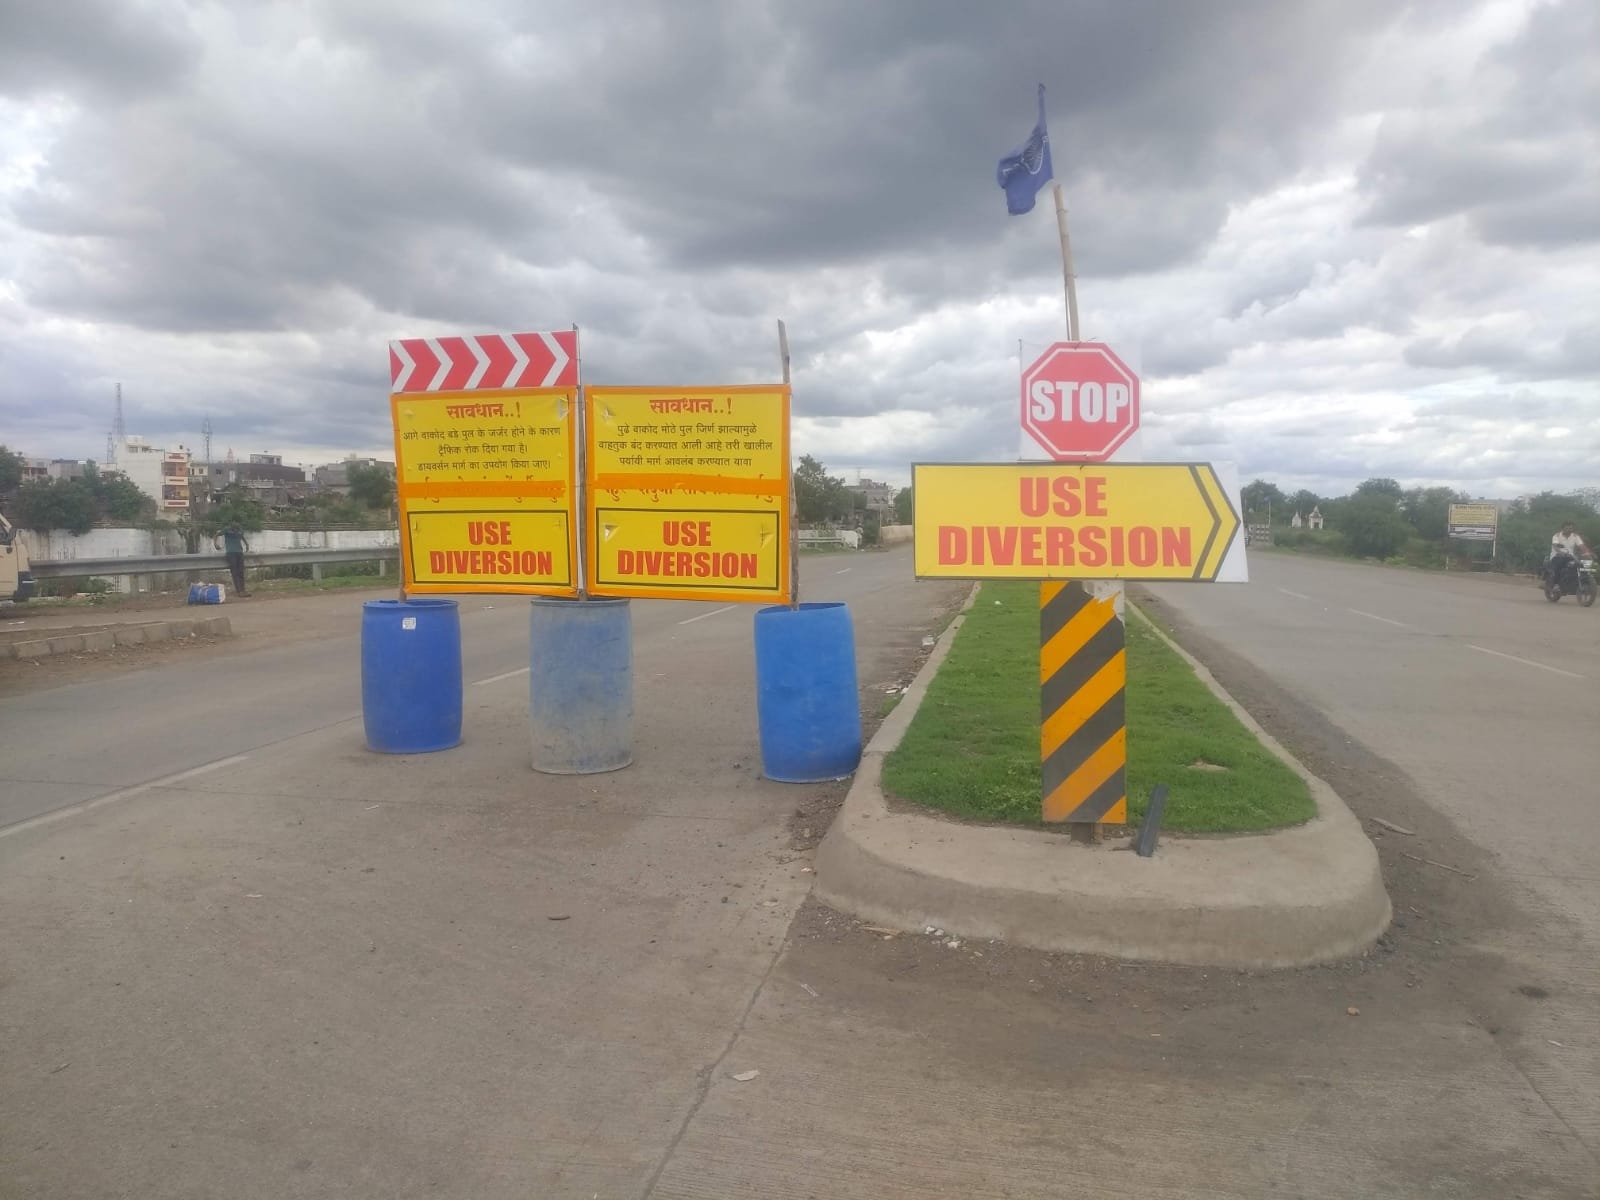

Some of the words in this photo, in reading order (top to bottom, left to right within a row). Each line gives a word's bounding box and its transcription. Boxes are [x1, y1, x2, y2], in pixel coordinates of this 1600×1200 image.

[1031, 380, 1128, 424] STOP
[403, 431, 418, 440] आगे
[462, 430, 474, 441] पुल
[478, 428, 485, 437] के
[511, 427, 524, 438] होने
[528, 426, 536, 436] के
[680, 425, 692, 436] पुल
[718, 422, 757, 436] झाल्यामुळे
[631, 440, 642, 450] बंद
[646, 442, 677, 450] करण्यात
[682, 439, 701, 449] आली
[706, 440, 722, 451] आहे
[726, 439, 739, 449] तरी
[744, 440, 772, 449] खालील
[647, 456, 661, 465] मार्ग
[698, 457, 730, 466] करण्यात
[1019, 477, 1107, 517] USE
[468, 522, 512, 545] USE
[663, 521, 712, 546] USE
[938, 526, 1192, 567] DIVERSION
[430, 551, 552, 575] DIVERSION
[617, 550, 758, 578] DIVERSION
